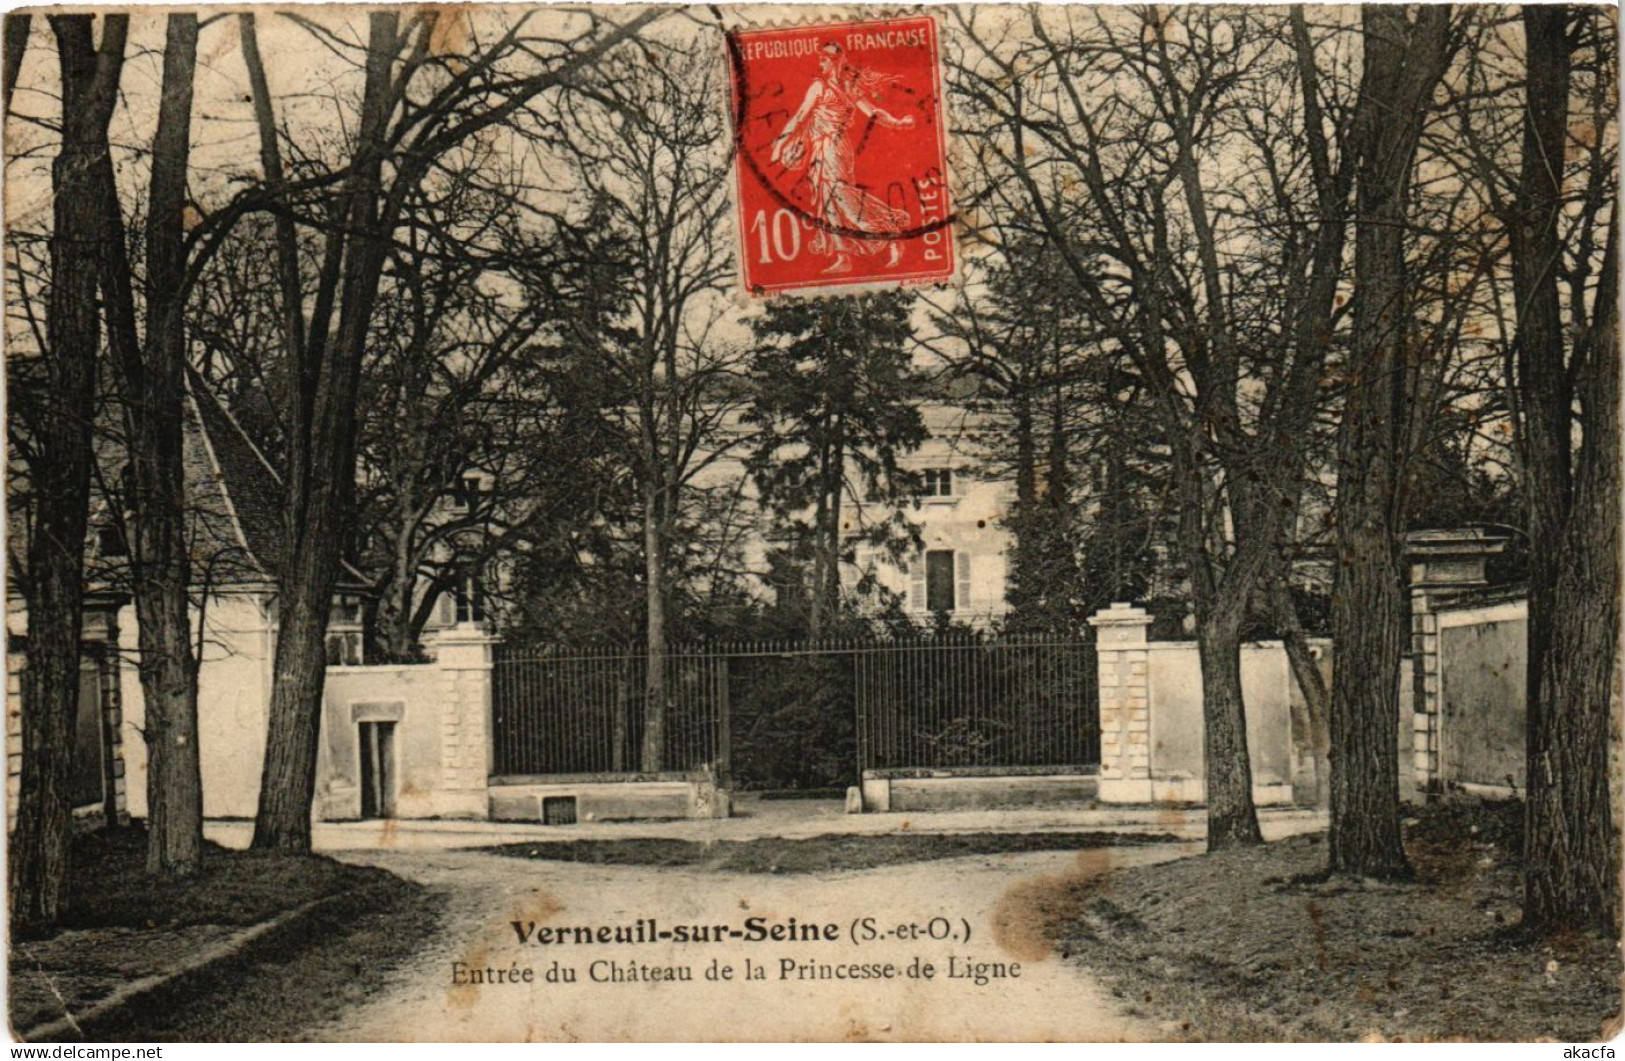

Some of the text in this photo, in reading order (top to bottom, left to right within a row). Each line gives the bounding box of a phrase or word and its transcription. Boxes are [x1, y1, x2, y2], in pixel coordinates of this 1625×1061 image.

[922, 178, 942, 261] POSTES
[510, 917, 970, 947] Verneuil-sur-Seine (S.-et-O.)
[451, 957, 1020, 986] Entrée du Château de la Princesse de Ligne
